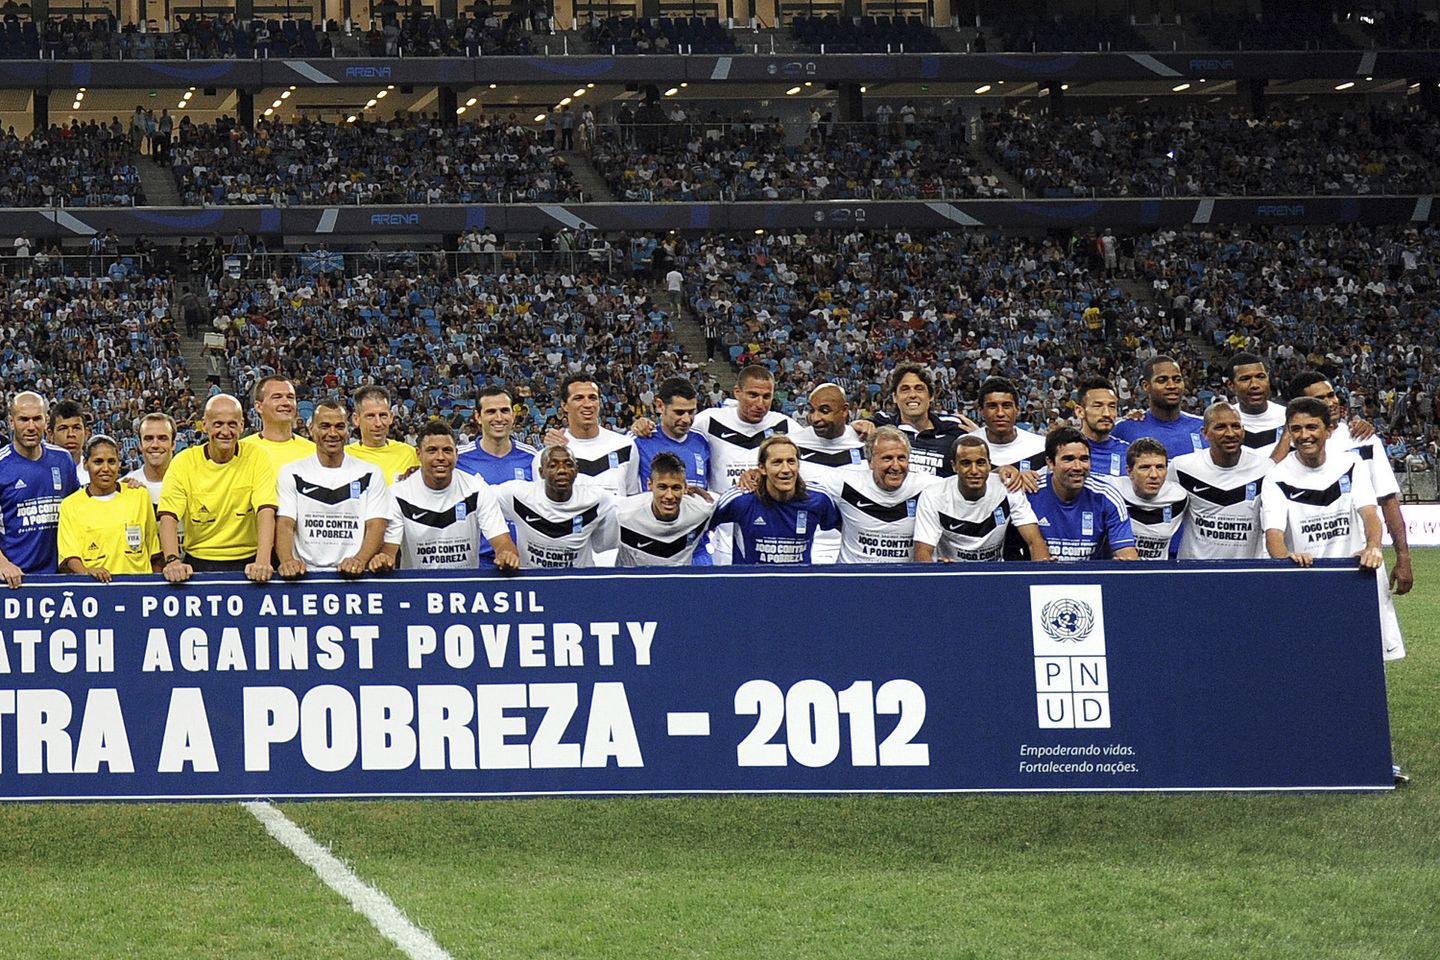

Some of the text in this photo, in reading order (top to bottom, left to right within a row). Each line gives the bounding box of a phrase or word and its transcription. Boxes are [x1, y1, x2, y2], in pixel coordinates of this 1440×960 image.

[345, 66, 391, 78] ARENA
[371, 213, 419, 225] ARENA
[38, 503, 61, 514] CONT
[30, 512, 59, 526] POBREZ
[304, 519, 359, 529] JOGO CONTRA
[1217, 521, 1252, 531] CONTRA
[1301, 523, 1322, 534] JOGO
[1323, 517, 1350, 530] CONTR
[309, 529, 353, 539] A POBREZA
[1200, 528, 1248, 541] A POBREZA
[1308, 534, 1314, 543] A
[858, 535, 914, 549] JOGO CONTRA
[417, 543, 471, 555] JOGO CONTRA
[863, 546, 909, 558] A POBREZA
[422, 553, 467, 564] A POBREZA
[142, 594, 244, 617] PORTO
[259, 593, 383, 615] ALEGRE
[427, 591, 545, 614] BRASIL
[142, 626, 380, 672] AGAINST
[407, 621, 658, 669] POVERTY
[157, 687, 220, 773] A
[242, 681, 645, 772] POBREZA
[733, 679, 930, 768] 2012
[1020, 744, 1136, 758] Empoderando vidas.
[1019, 761, 1139, 775] Fortalecendo nações.
